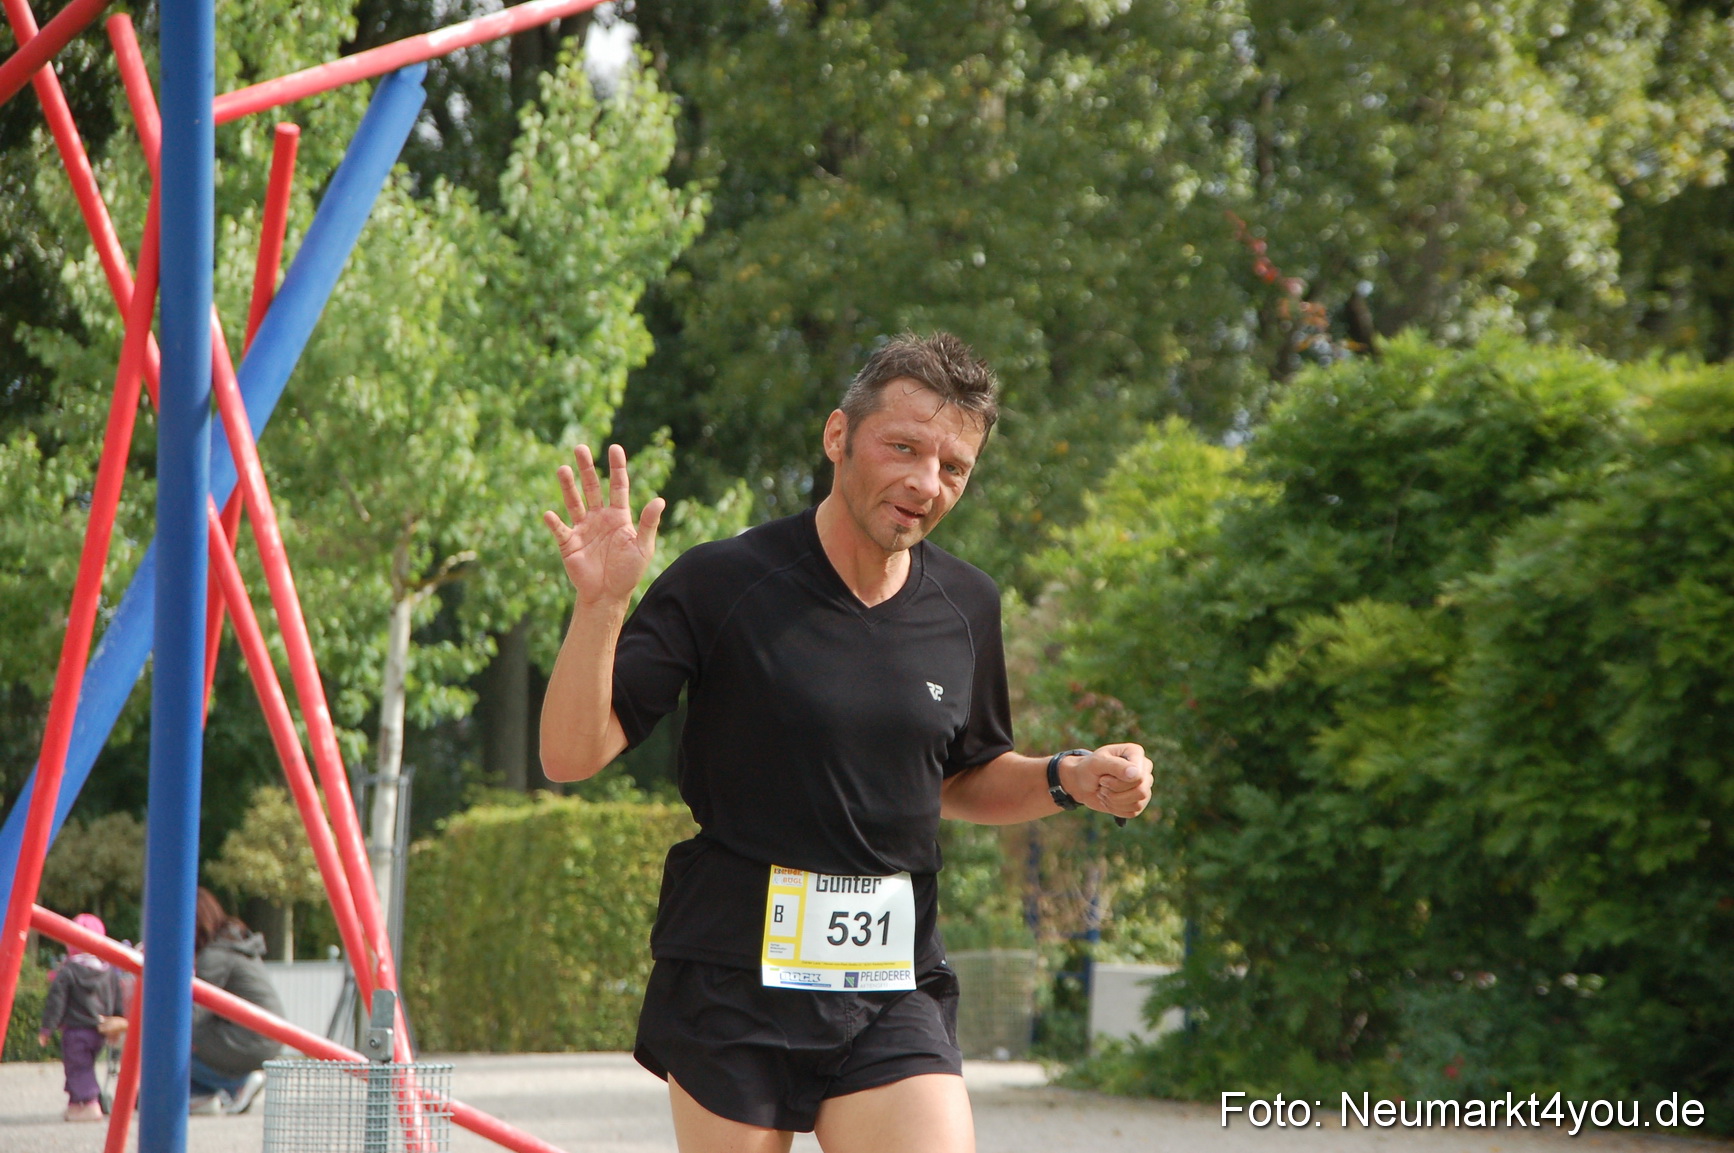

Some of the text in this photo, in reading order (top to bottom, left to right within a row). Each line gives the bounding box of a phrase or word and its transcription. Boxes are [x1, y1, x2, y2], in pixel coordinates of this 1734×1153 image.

[774, 904, 784, 923] B
[826, 910, 891, 947] 531
[860, 969, 911, 982] PFLEIDERER
